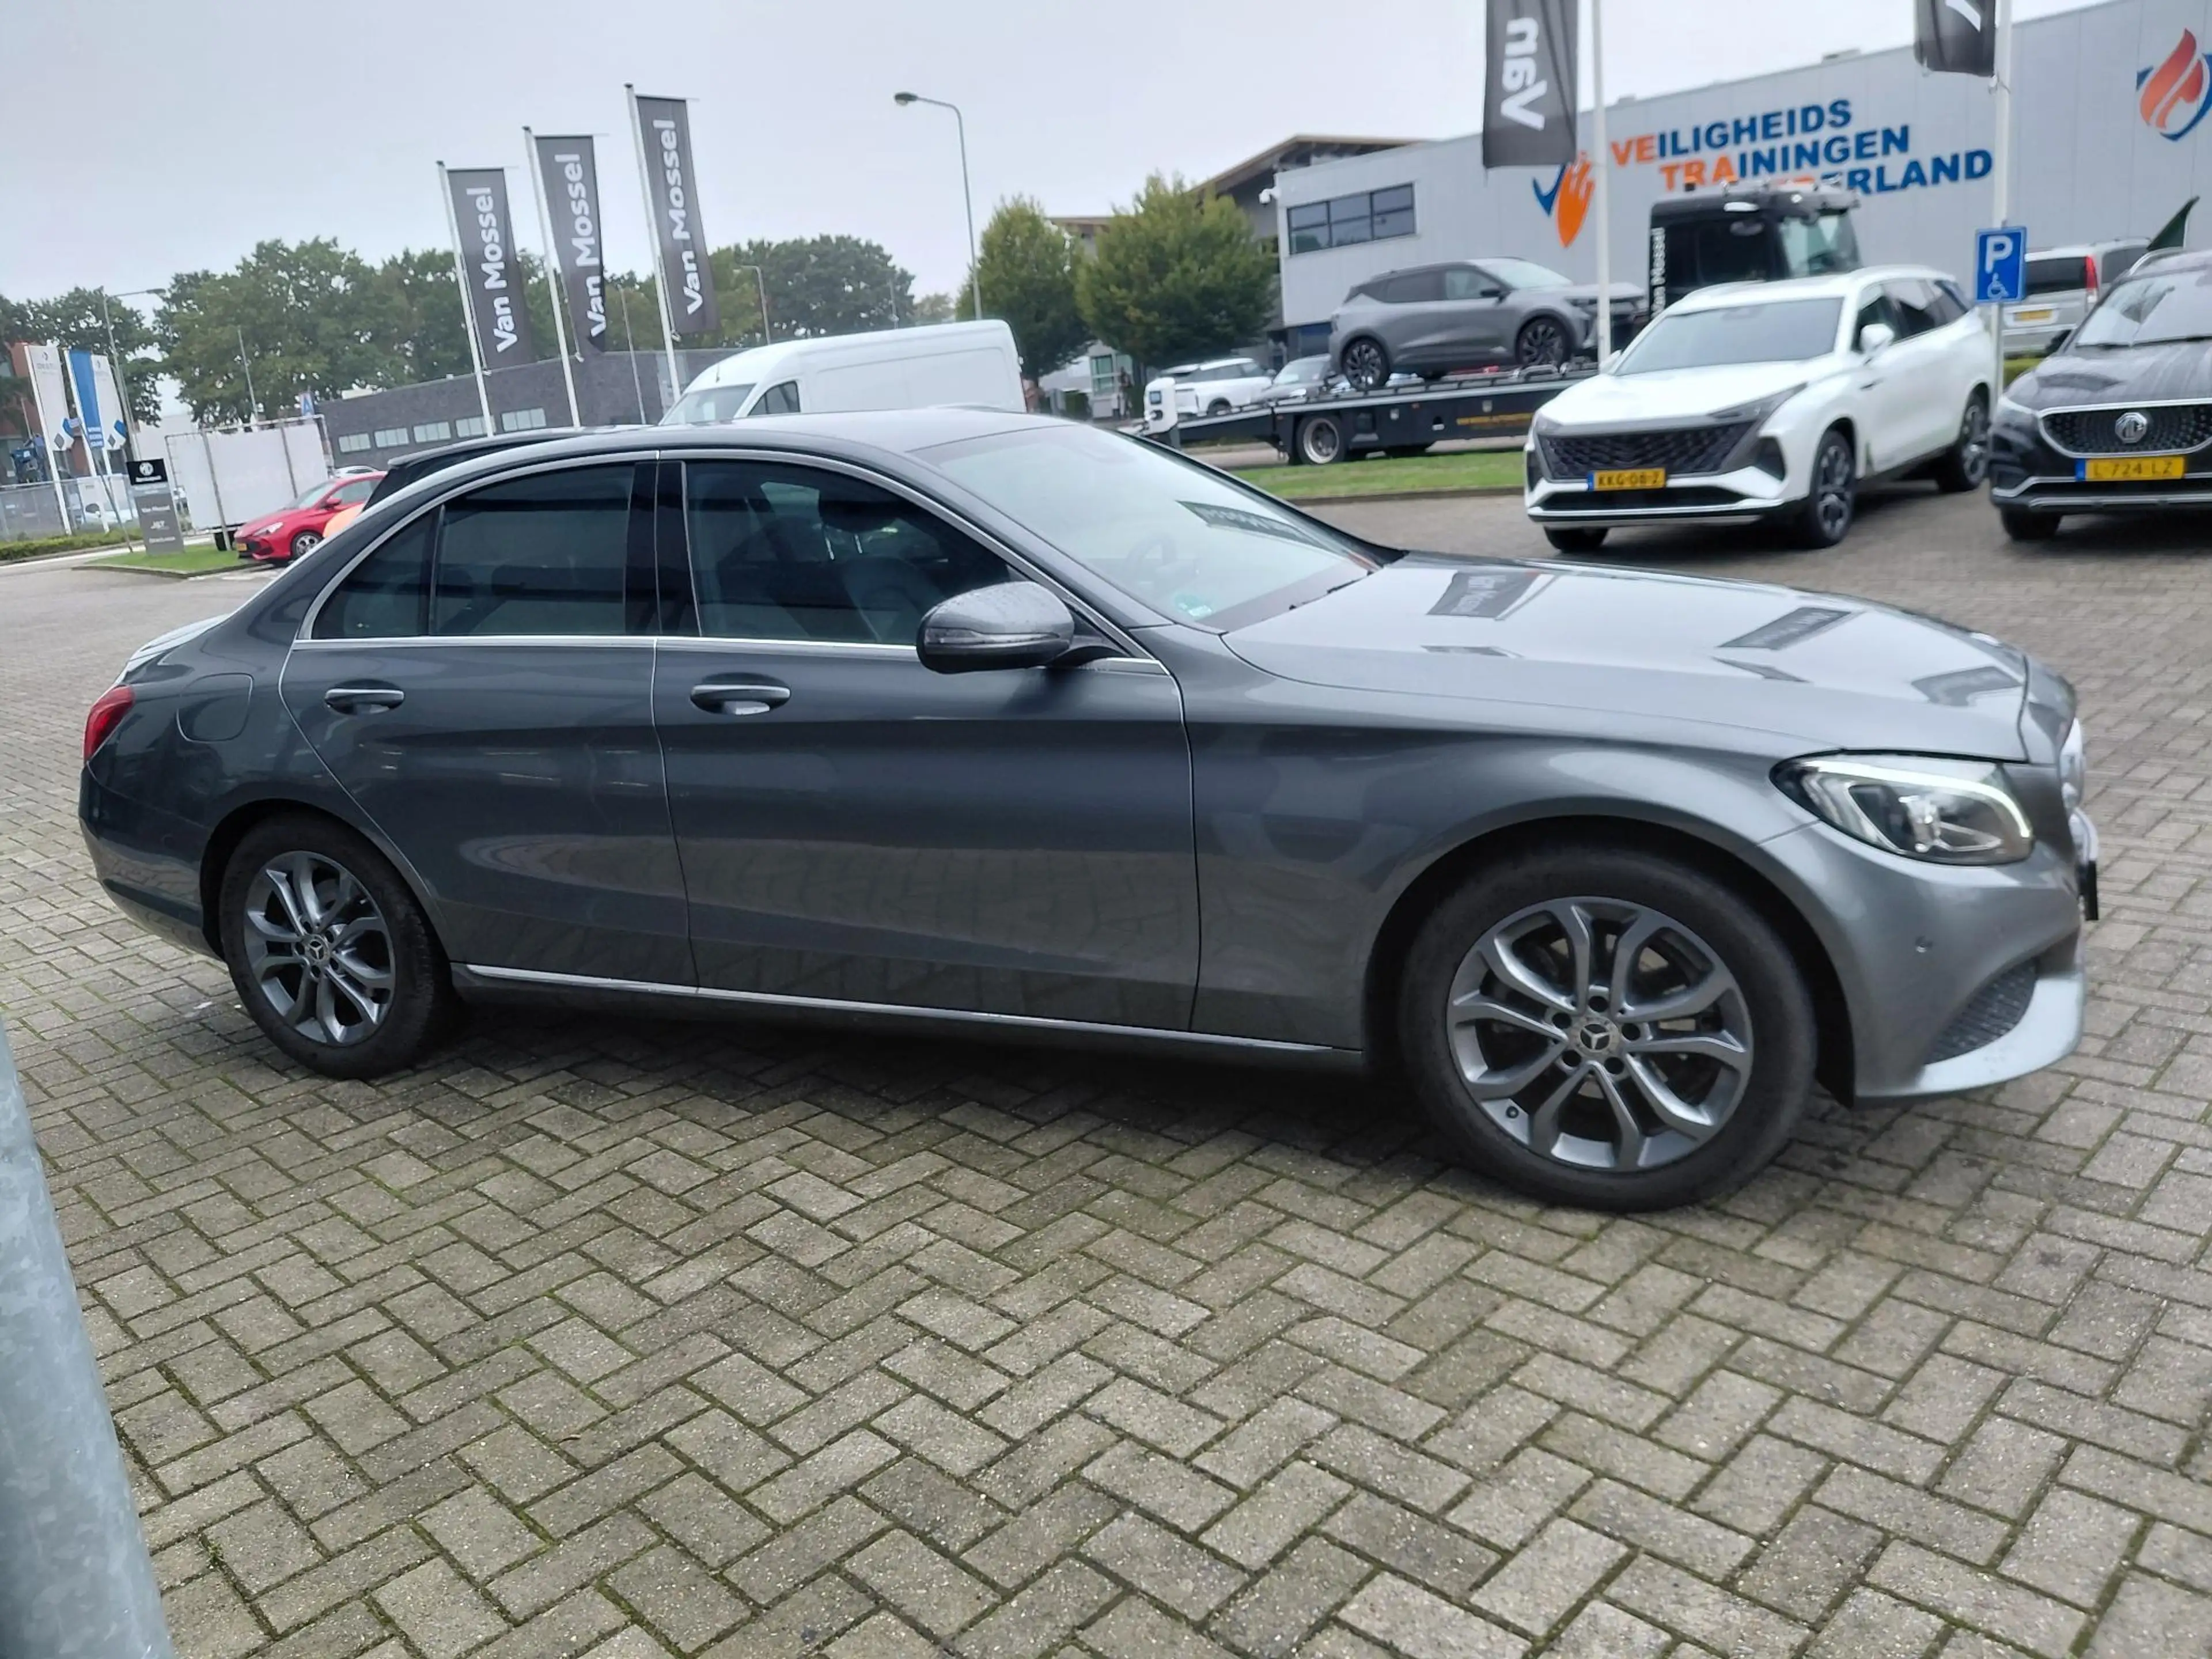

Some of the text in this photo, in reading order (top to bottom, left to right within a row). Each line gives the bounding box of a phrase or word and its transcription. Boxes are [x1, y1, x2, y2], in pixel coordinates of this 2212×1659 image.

[1611, 99, 1852, 166] VEILIGHEIDS
[1660, 124, 1909, 192] TRAININGEN
[465, 187, 518, 353] Van Mossel
[554, 153, 607, 338] Van Mossel
[653, 119, 703, 315] Van Mossel
[1985, 235, 2013, 274] P
